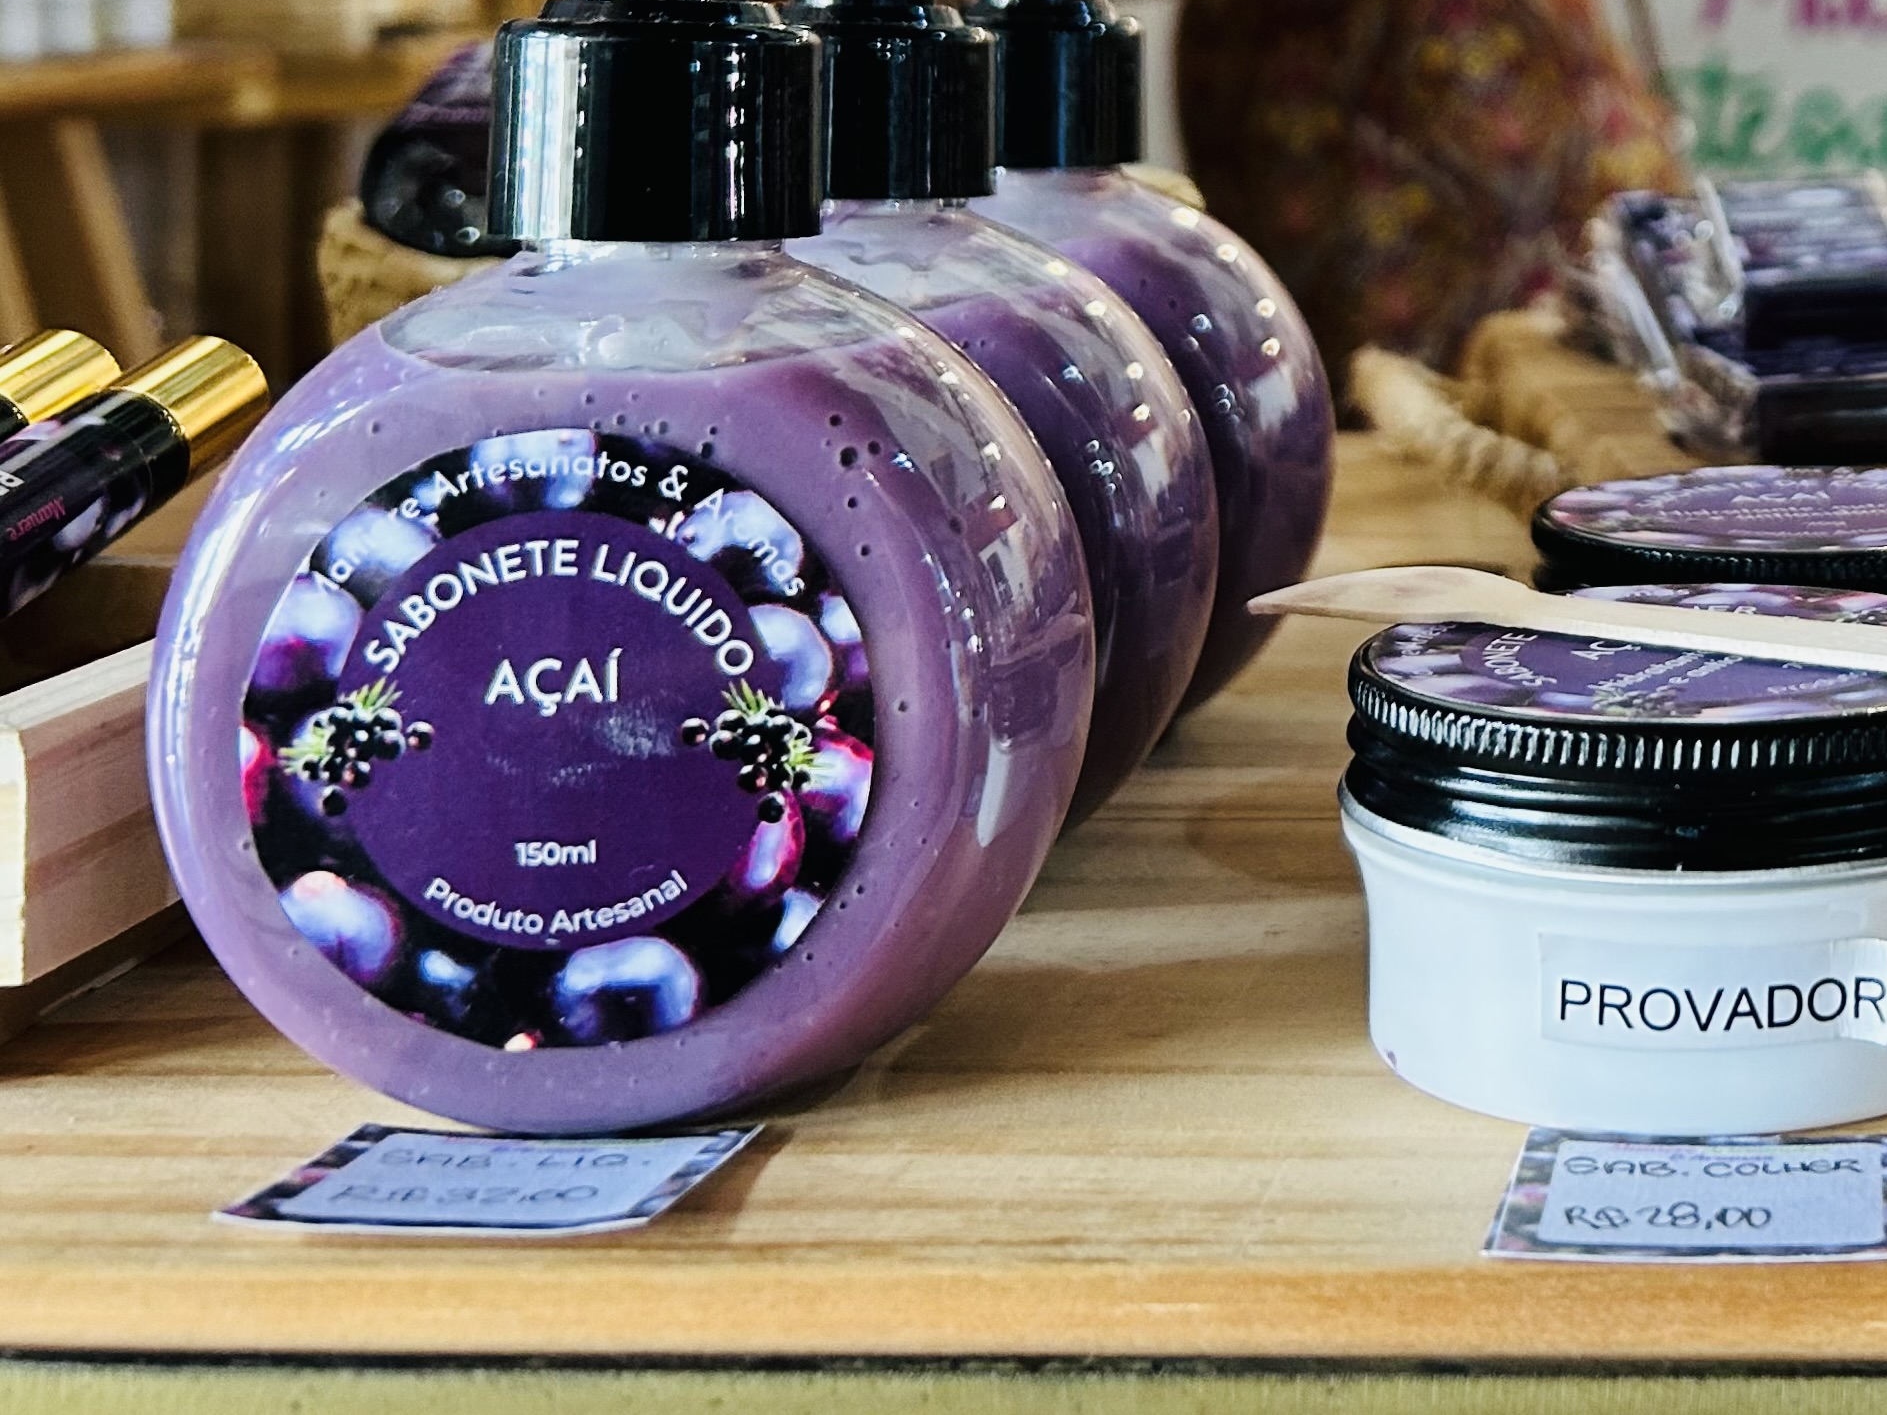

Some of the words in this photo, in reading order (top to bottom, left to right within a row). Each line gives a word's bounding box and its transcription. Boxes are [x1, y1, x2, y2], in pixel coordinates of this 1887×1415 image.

[425, 449, 648, 505] Artesanatos
[657, 465, 690, 501] &
[364, 538, 581, 674] SABONETE
[592, 543, 755, 676] LIQUIDO
[484, 647, 624, 717] AÇAÍ
[1483, 631, 1558, 687] SABONETE
[515, 839, 598, 867] 150ml
[423, 876, 546, 935] Produto
[547, 870, 689, 936] Artesanal
[1559, 977, 1887, 1031] PROVADOR
[1702, 1156, 1863, 1178] COLHER
